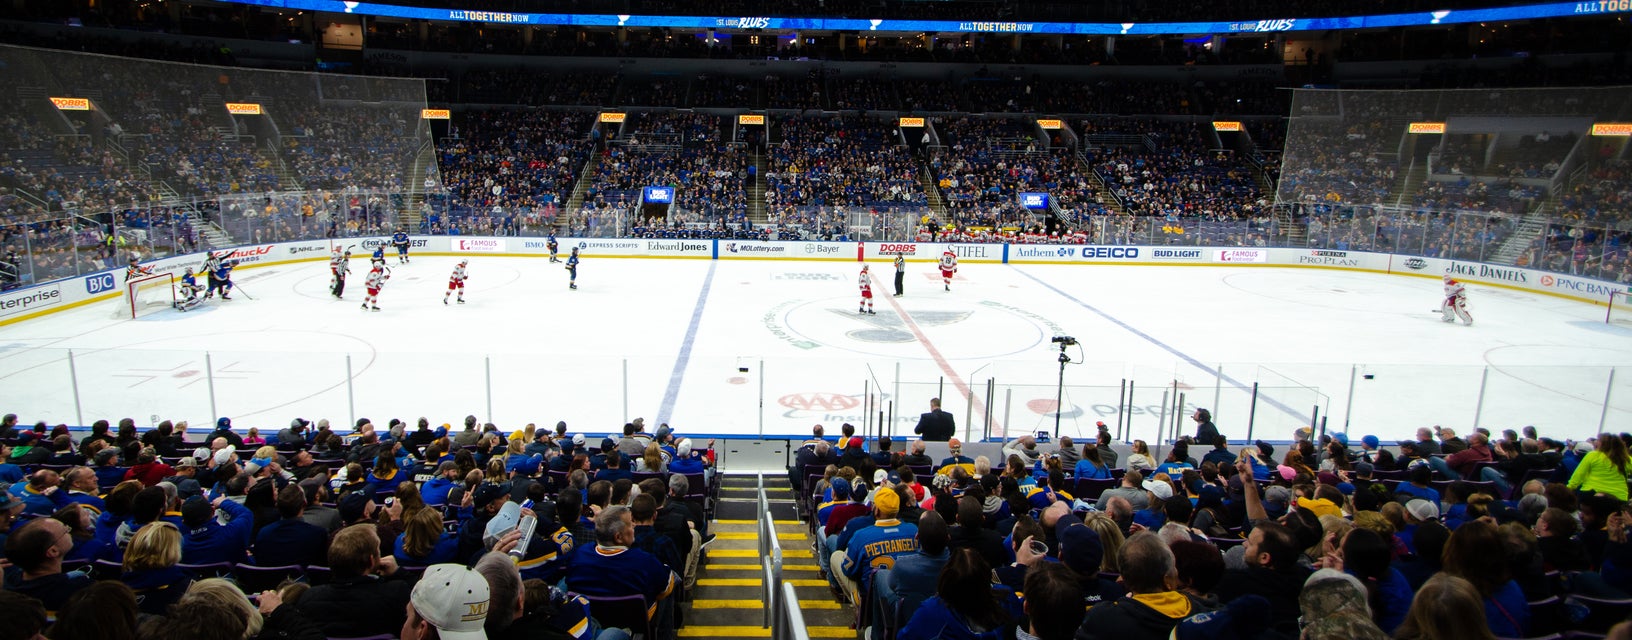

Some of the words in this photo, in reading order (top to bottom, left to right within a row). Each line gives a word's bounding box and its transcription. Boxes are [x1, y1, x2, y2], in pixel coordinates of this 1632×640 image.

[738, 17, 770, 28] BLUES
[1255, 18, 1296, 32] BLUES
[648, 242, 679, 251] Edward
[680, 243, 707, 251] Jones
[740, 244, 784, 252] MOLottery.com
[817, 245, 840, 254] Bayer
[880, 244, 916, 252] DOBBS
[947, 244, 988, 258] STIFEL
[1016, 248, 1054, 257] Anthem
[1082, 248, 1139, 258] GEICO
[1446, 261, 1475, 276] JACK
[89, 275, 113, 293] BJC
[1557, 278, 1584, 291] PNC
[1586, 284, 1623, 298] BANK
